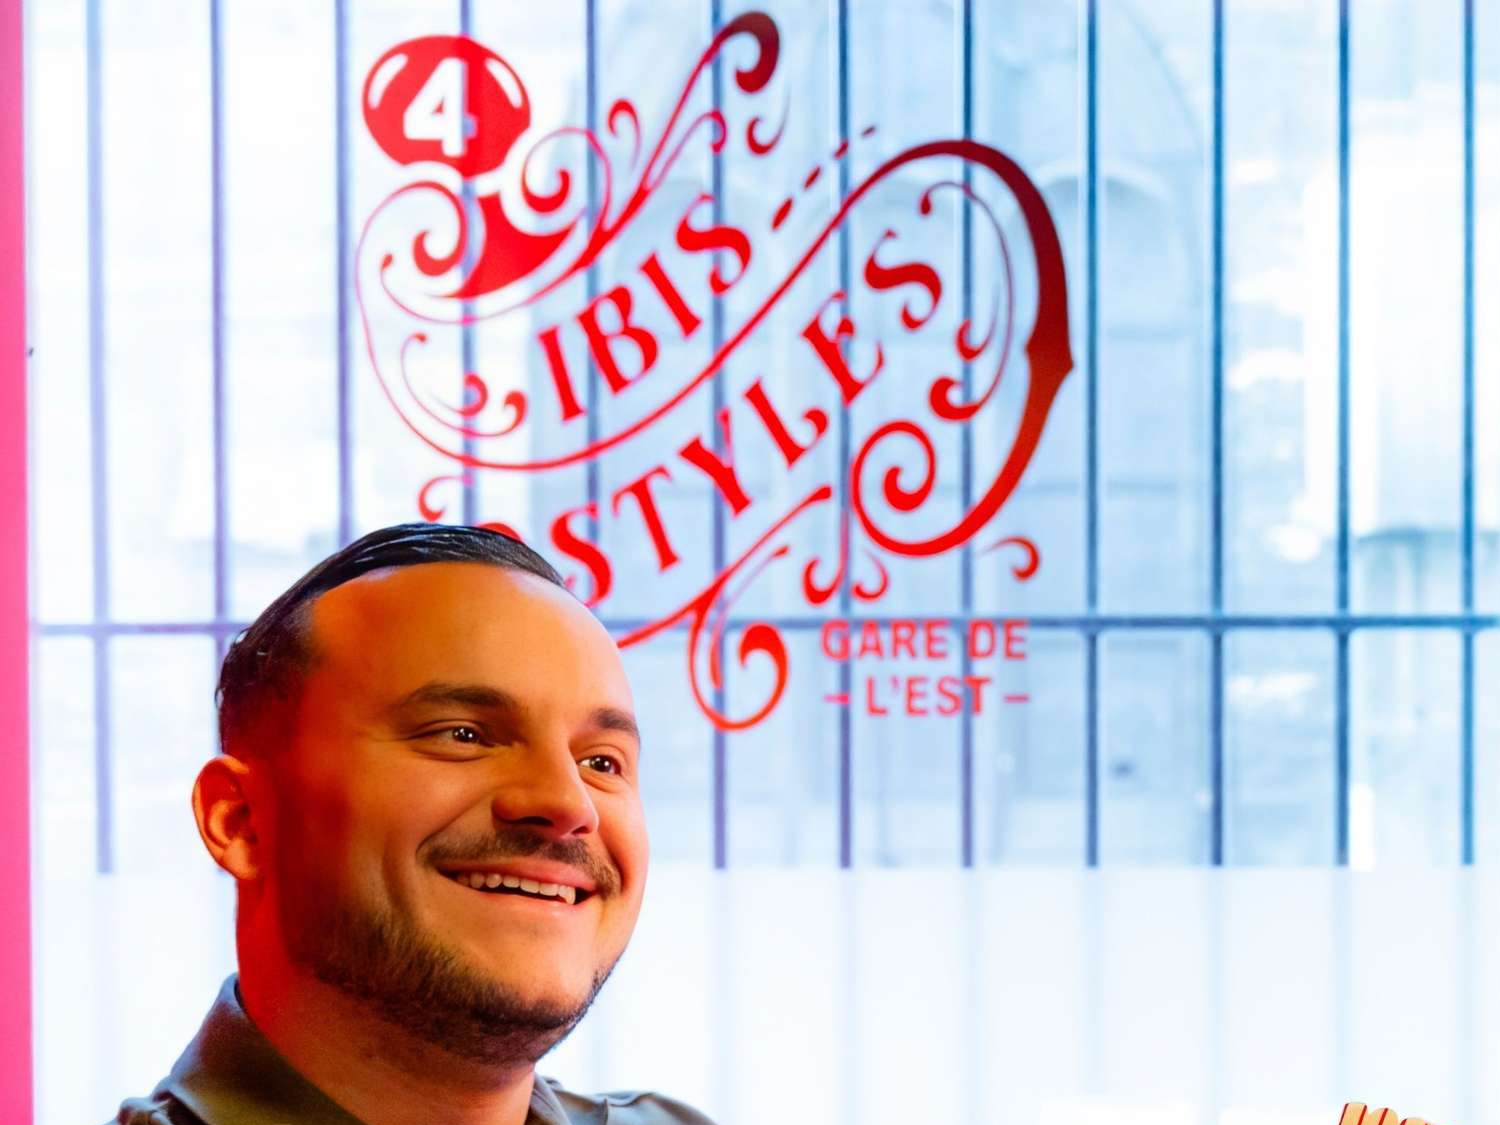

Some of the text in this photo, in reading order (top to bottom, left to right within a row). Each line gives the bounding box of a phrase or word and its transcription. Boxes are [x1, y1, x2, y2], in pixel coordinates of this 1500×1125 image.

[402, 56, 475, 157] 4
[538, 193, 753, 423] IBIS
[549, 229, 944, 608] STYLES
[820, 618, 1029, 661] GARE DE
